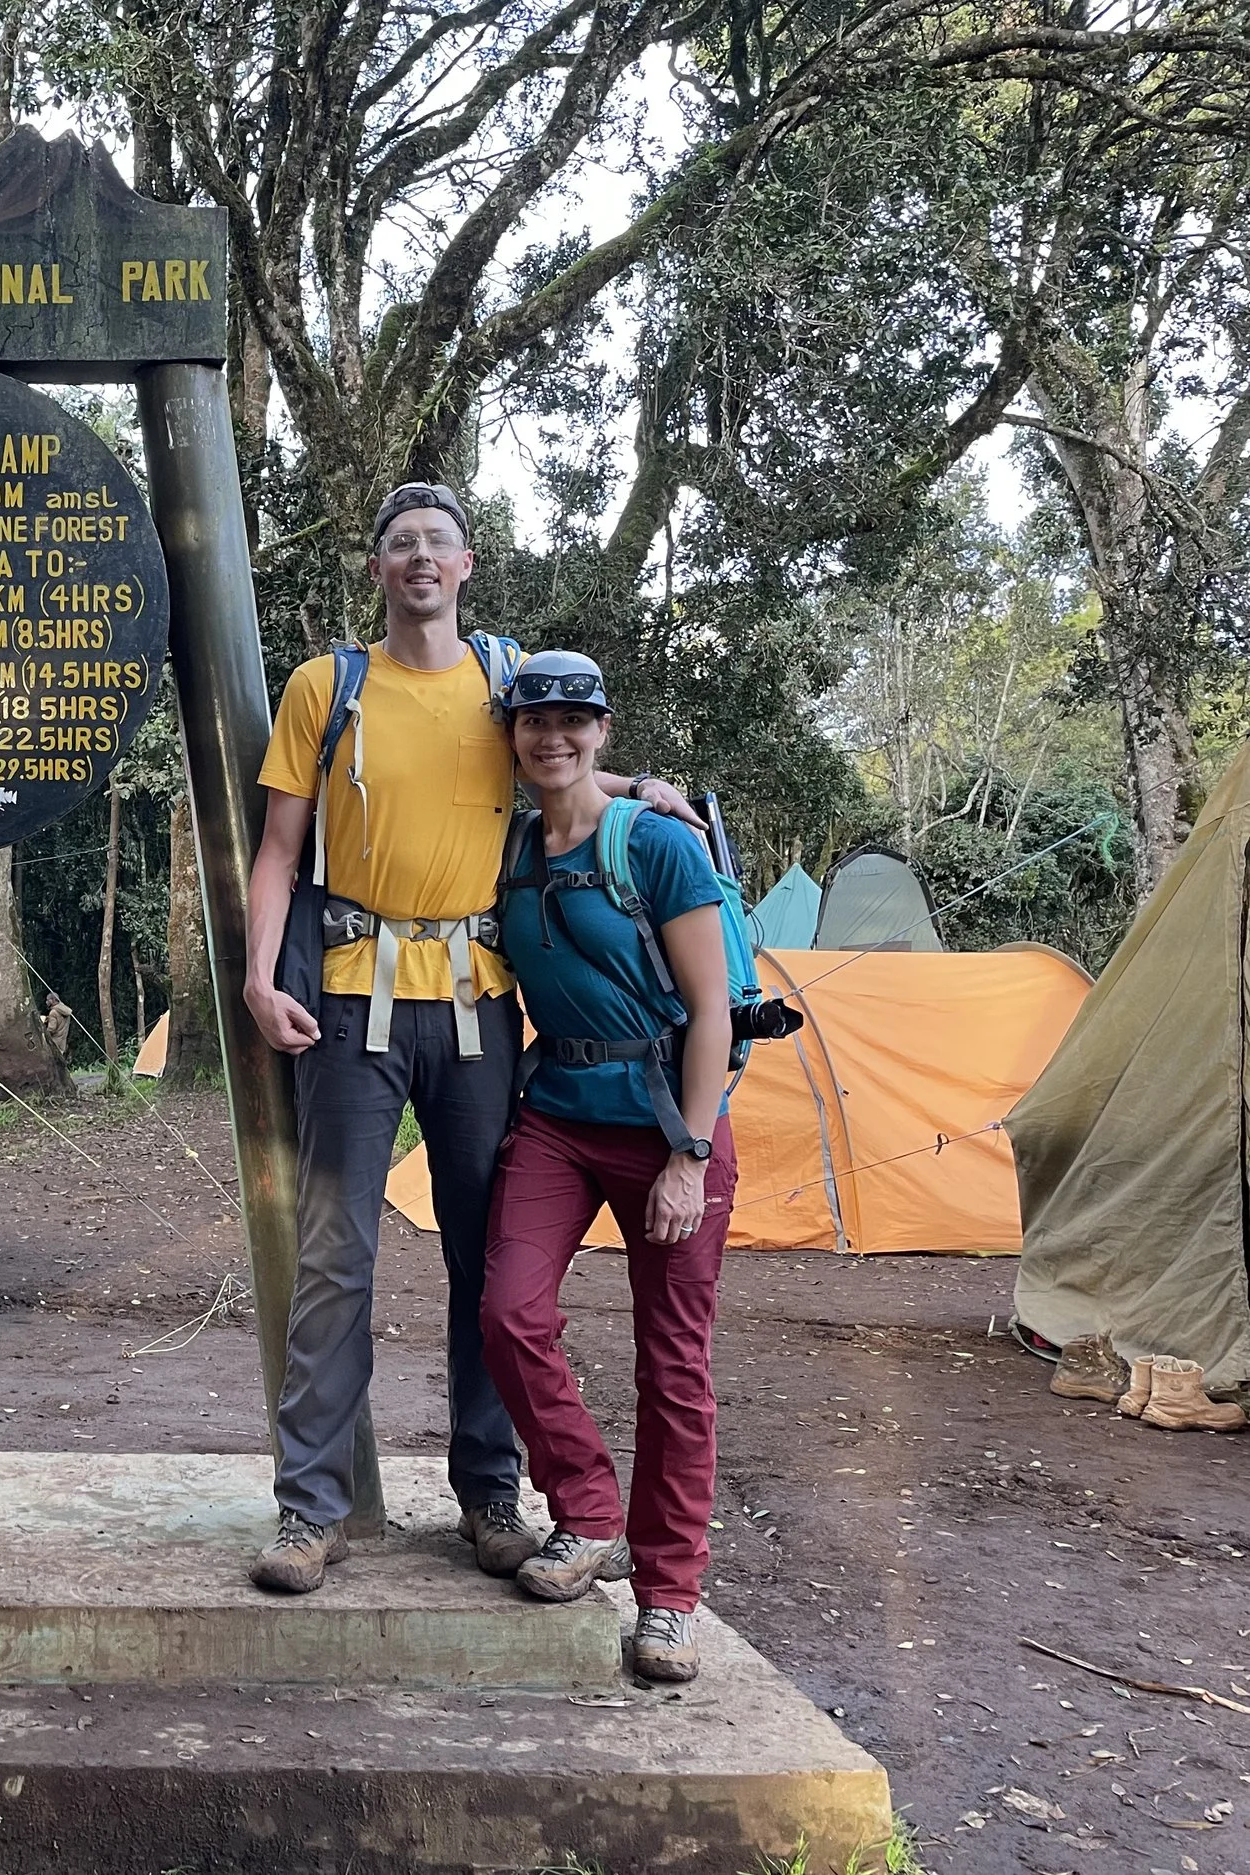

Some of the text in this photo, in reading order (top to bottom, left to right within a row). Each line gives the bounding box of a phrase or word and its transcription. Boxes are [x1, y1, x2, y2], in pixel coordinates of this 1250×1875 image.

[121, 259, 211, 303] PARK
[34, 515, 130, 543] FOREST
[40, 574, 145, 620] (4HRS)
